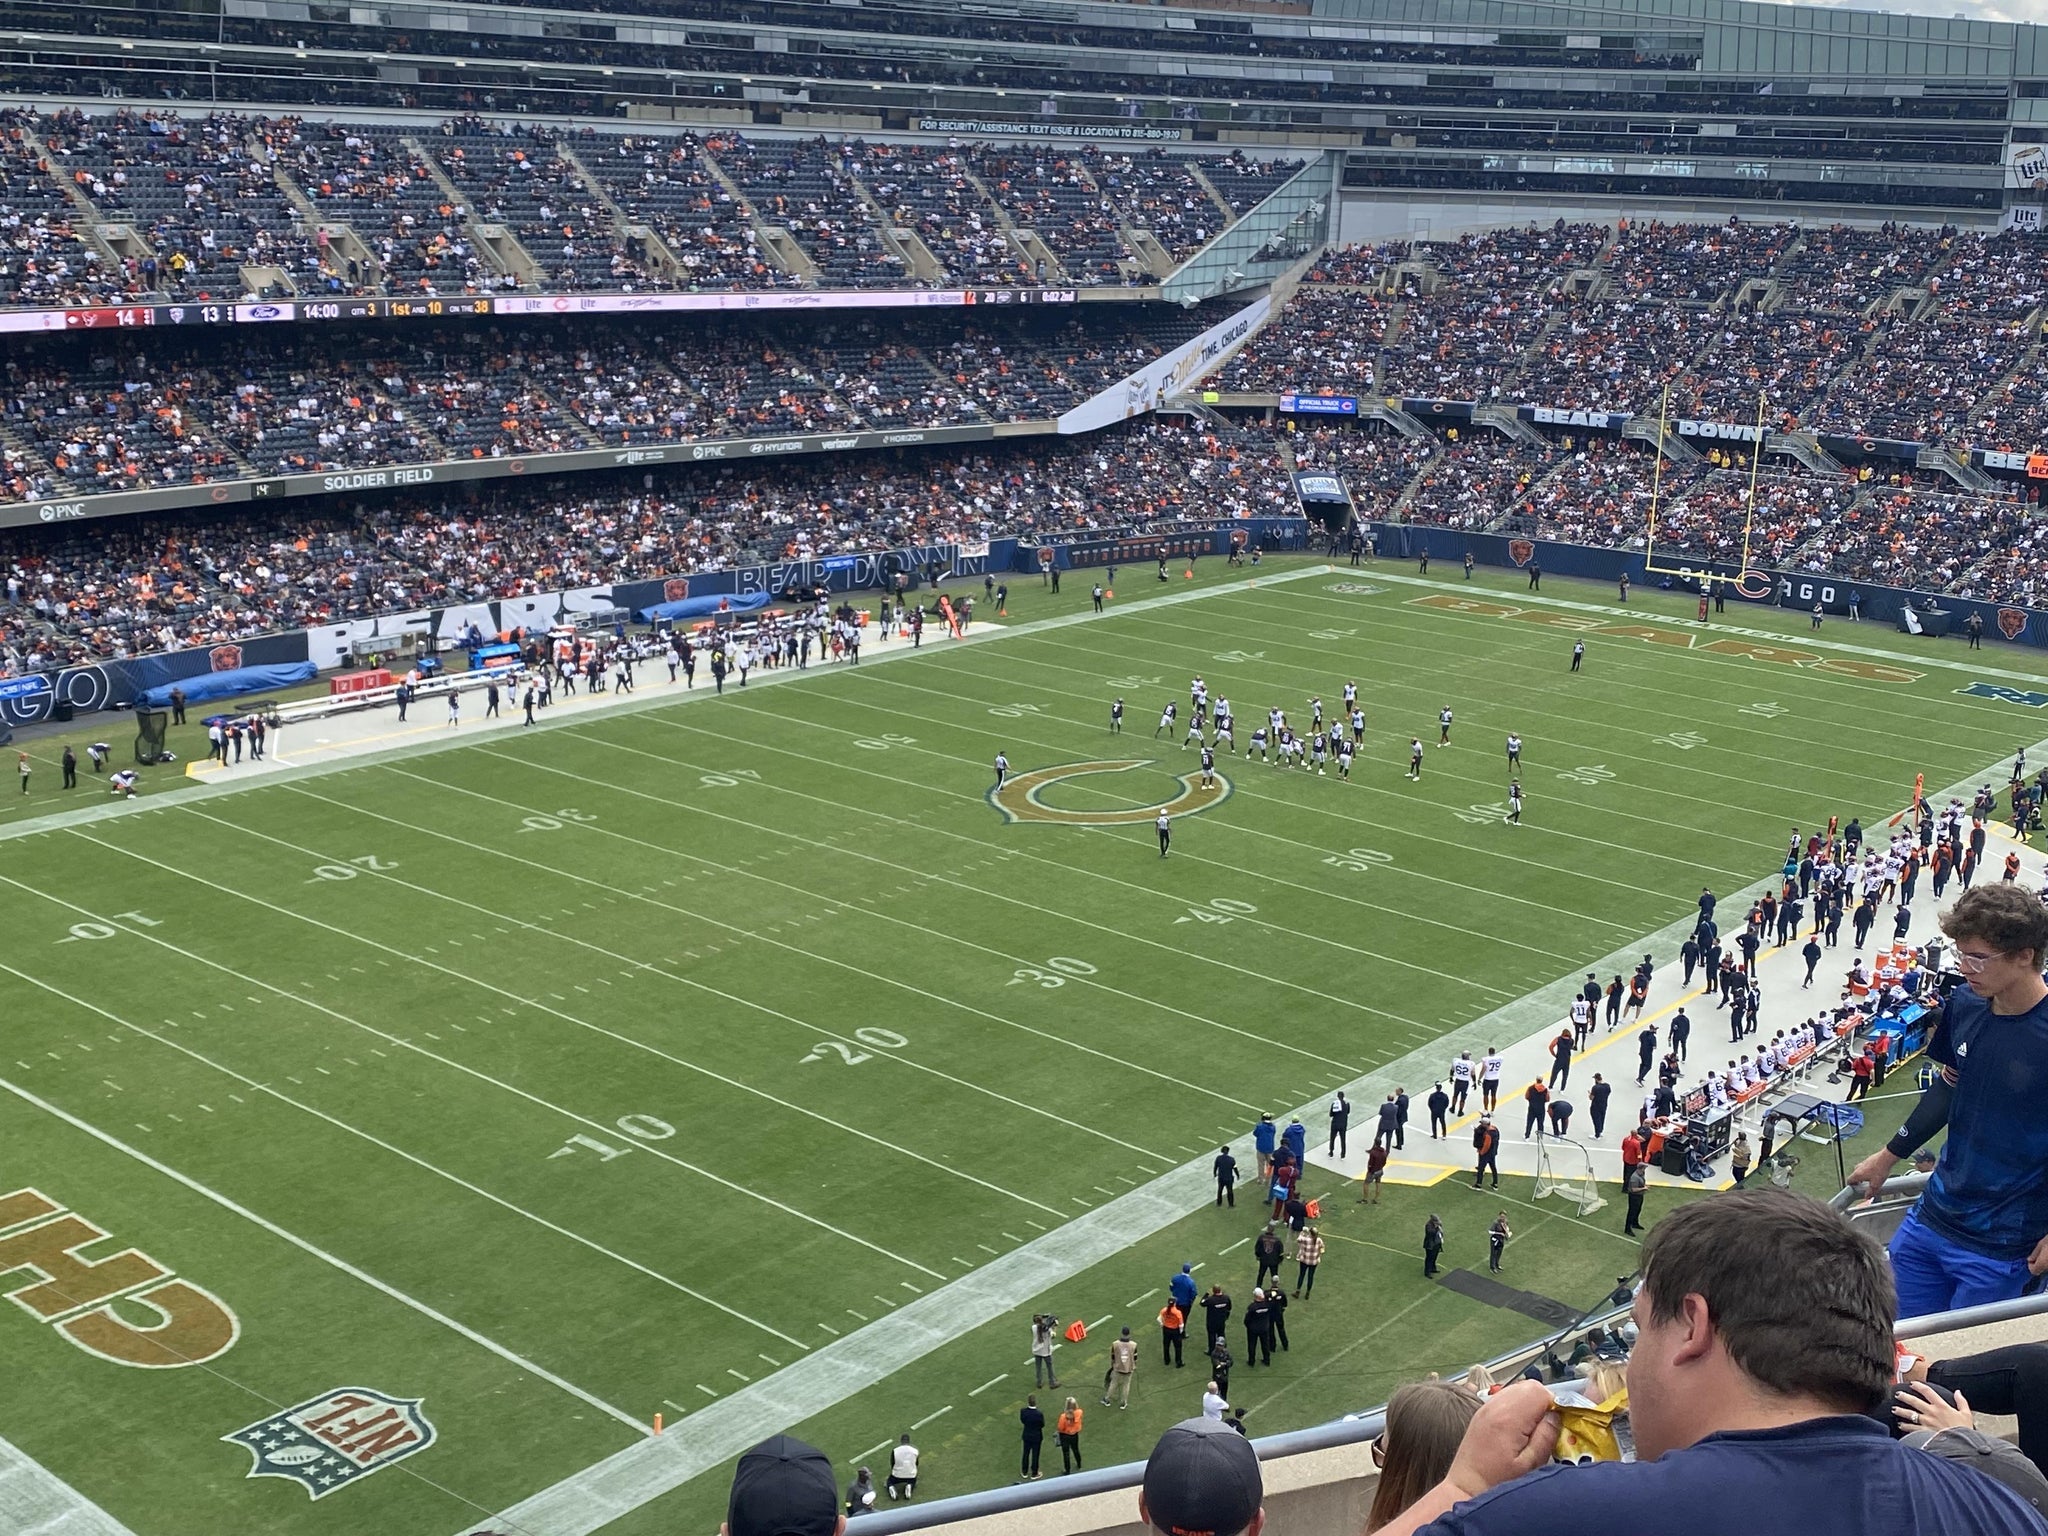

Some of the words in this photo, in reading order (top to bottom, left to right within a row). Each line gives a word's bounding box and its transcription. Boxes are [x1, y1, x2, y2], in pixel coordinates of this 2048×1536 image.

[919, 120, 938, 131] FOR
[938, 120, 1029, 134] SECURITY/ASSISTANCE
[1029, 124, 1050, 135] TEXT
[1050, 125, 1073, 136] ISSUE
[1080, 127, 1120, 138] LOCATION
[1121, 128, 1132, 138] TO
[2020, 157, 2047, 179] Lite
[2013, 209, 2038, 223] Lite
[580, 298, 596, 310] Lite
[984, 292, 995, 303] 20
[1020, 292, 1027, 302] 6
[1060, 291, 1075, 302] 2nd
[252, 306, 275, 318] Ford
[303, 303, 340, 319] 14:00
[351, 307, 366, 316] QTR
[367, 302, 377, 316] 3
[391, 302, 410, 316] 1st
[411, 306, 426, 314] AND
[428, 301, 442, 315] 10
[460, 305, 474, 313] THE
[474, 300, 489, 313] 38
[525, 299, 542, 312] Lite
[115, 309, 136, 327] 14
[200, 306, 220, 323] 13
[1221, 320, 1248, 348] CHICAGO
[1533, 408, 1609, 428] BEAR
[889, 433, 924, 443] HORIZON
[1678, 421, 1764, 442] DOWN
[704, 445, 725, 458] PNC
[764, 441, 803, 452] HYUNDAI
[821, 437, 858, 450] verizon
[627, 450, 645, 465] Lite
[1984, 452, 2026, 470] BE
[323, 472, 387, 491] SOLDIER
[393, 468, 433, 484] FIELD
[55, 503, 86, 518] PNC
[1402, 594, 1929, 684] BEARS
[21, 682, 39, 691] NFL
[988, 703, 1041, 718] 40
[1738, 702, 1790, 719] 10
[853, 732, 918, 751] 50
[1652, 731, 1709, 750] 20
[703, 767, 764, 789] 40
[1556, 765, 1617, 786] 30
[521, 807, 598, 832] 30
[1452, 803, 1513, 825] 40
[312, 854, 400, 881] 20
[1321, 847, 1394, 872] 50
[1187, 897, 1258, 925] 40
[68, 909, 164, 940] 10
[1012, 955, 1099, 989] 30
[1576, 1006, 1586, 1016] 11
[810, 1026, 910, 1067] 20
[1455, 1064, 1469, 1076] 62
[1488, 1061, 1501, 1072] 79
[564, 1113, 677, 1162] 10
[302, 1394, 418, 1464] NFL
